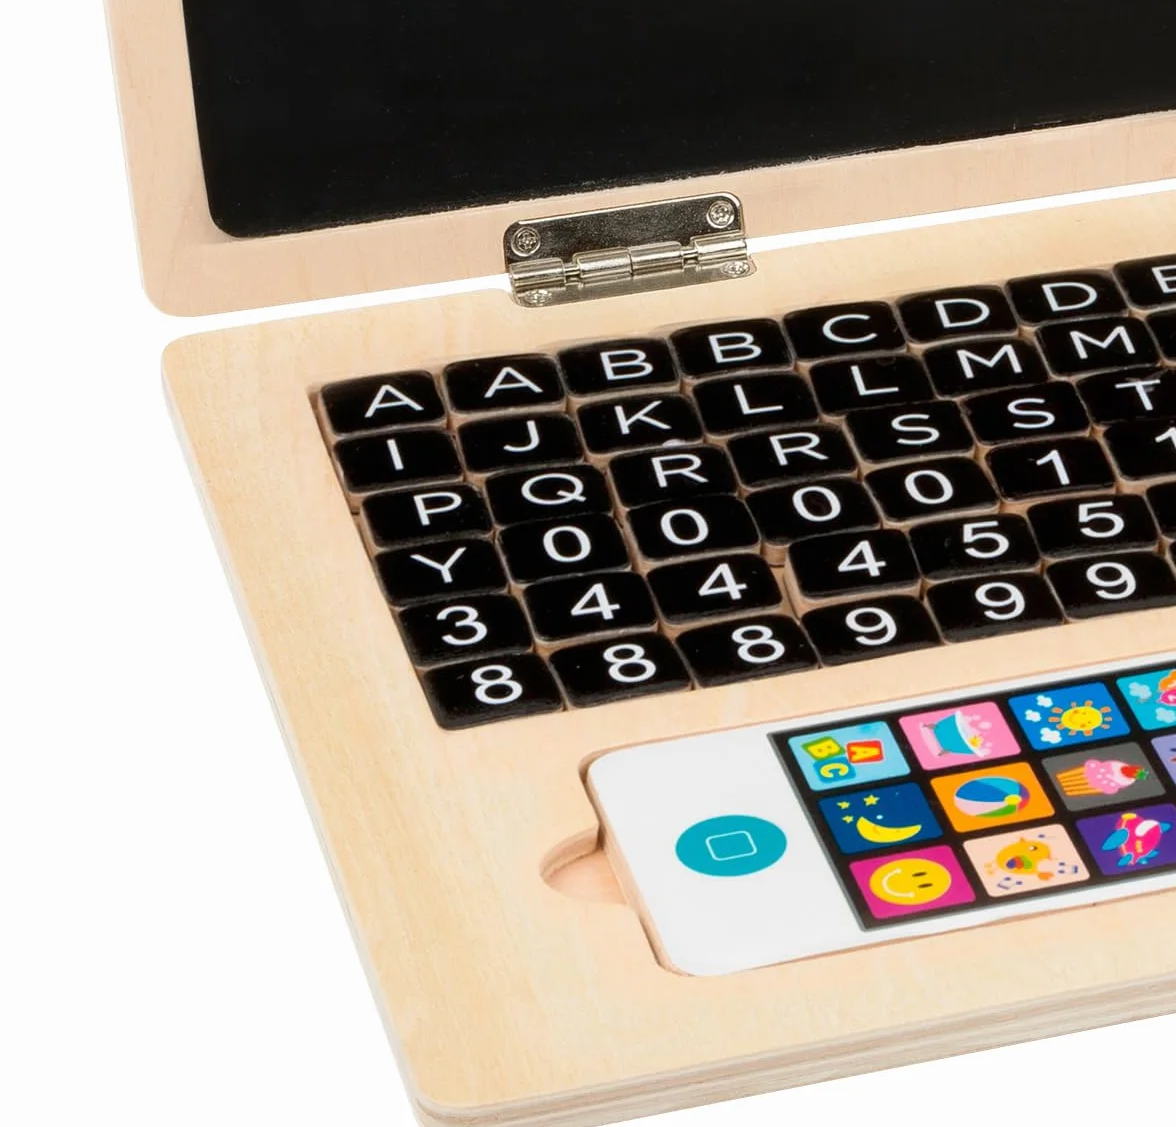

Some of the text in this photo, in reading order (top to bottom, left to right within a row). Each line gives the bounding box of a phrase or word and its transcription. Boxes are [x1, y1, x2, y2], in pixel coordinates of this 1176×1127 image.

[365, 384, 423, 418] A
[484, 366, 543, 398] A
[600, 349, 653, 380] B
[708, 332, 762, 363] B
[822, 314, 877, 343] C
[935, 298, 990, 328] D
[1041, 282, 1098, 312] D
[386, 439, 404, 470] I
[503, 420, 540, 452] J
[614, 400, 671, 435] K
[733, 384, 784, 415] L
[850, 365, 899, 396] L
[956, 344, 1022, 379] M
[1069, 326, 1136, 359] M
[410, 547, 466, 583] Y
[543, 525, 591, 562] 0
[660, 508, 709, 545] 0
[792, 486, 841, 522] 0
[904, 469, 954, 505] 0
[1036, 449, 1070, 485] 1
[413, 491, 462, 526] P
[521, 473, 586, 505] Q
[651, 454, 708, 488] R
[769, 432, 828, 466] R
[891, 413, 940, 445] S
[1007, 398, 1055, 429] S
[1115, 379, 1161, 411] T
[436, 605, 488, 646] 3
[570, 583, 620, 620] 4
[698, 563, 747, 600] 4
[837, 540, 886, 577] 4
[963, 520, 1009, 559] 5
[1078, 501, 1125, 538] 5
[471, 664, 523, 705] 8
[603, 643, 657, 683] 8
[731, 625, 785, 664] 8
[845, 607, 897, 646] 9
[975, 582, 1025, 620] 9
[1086, 561, 1137, 600] 9
[806, 738, 841, 759] B
[819, 762, 849, 778] C
[850, 746, 880, 762] A
